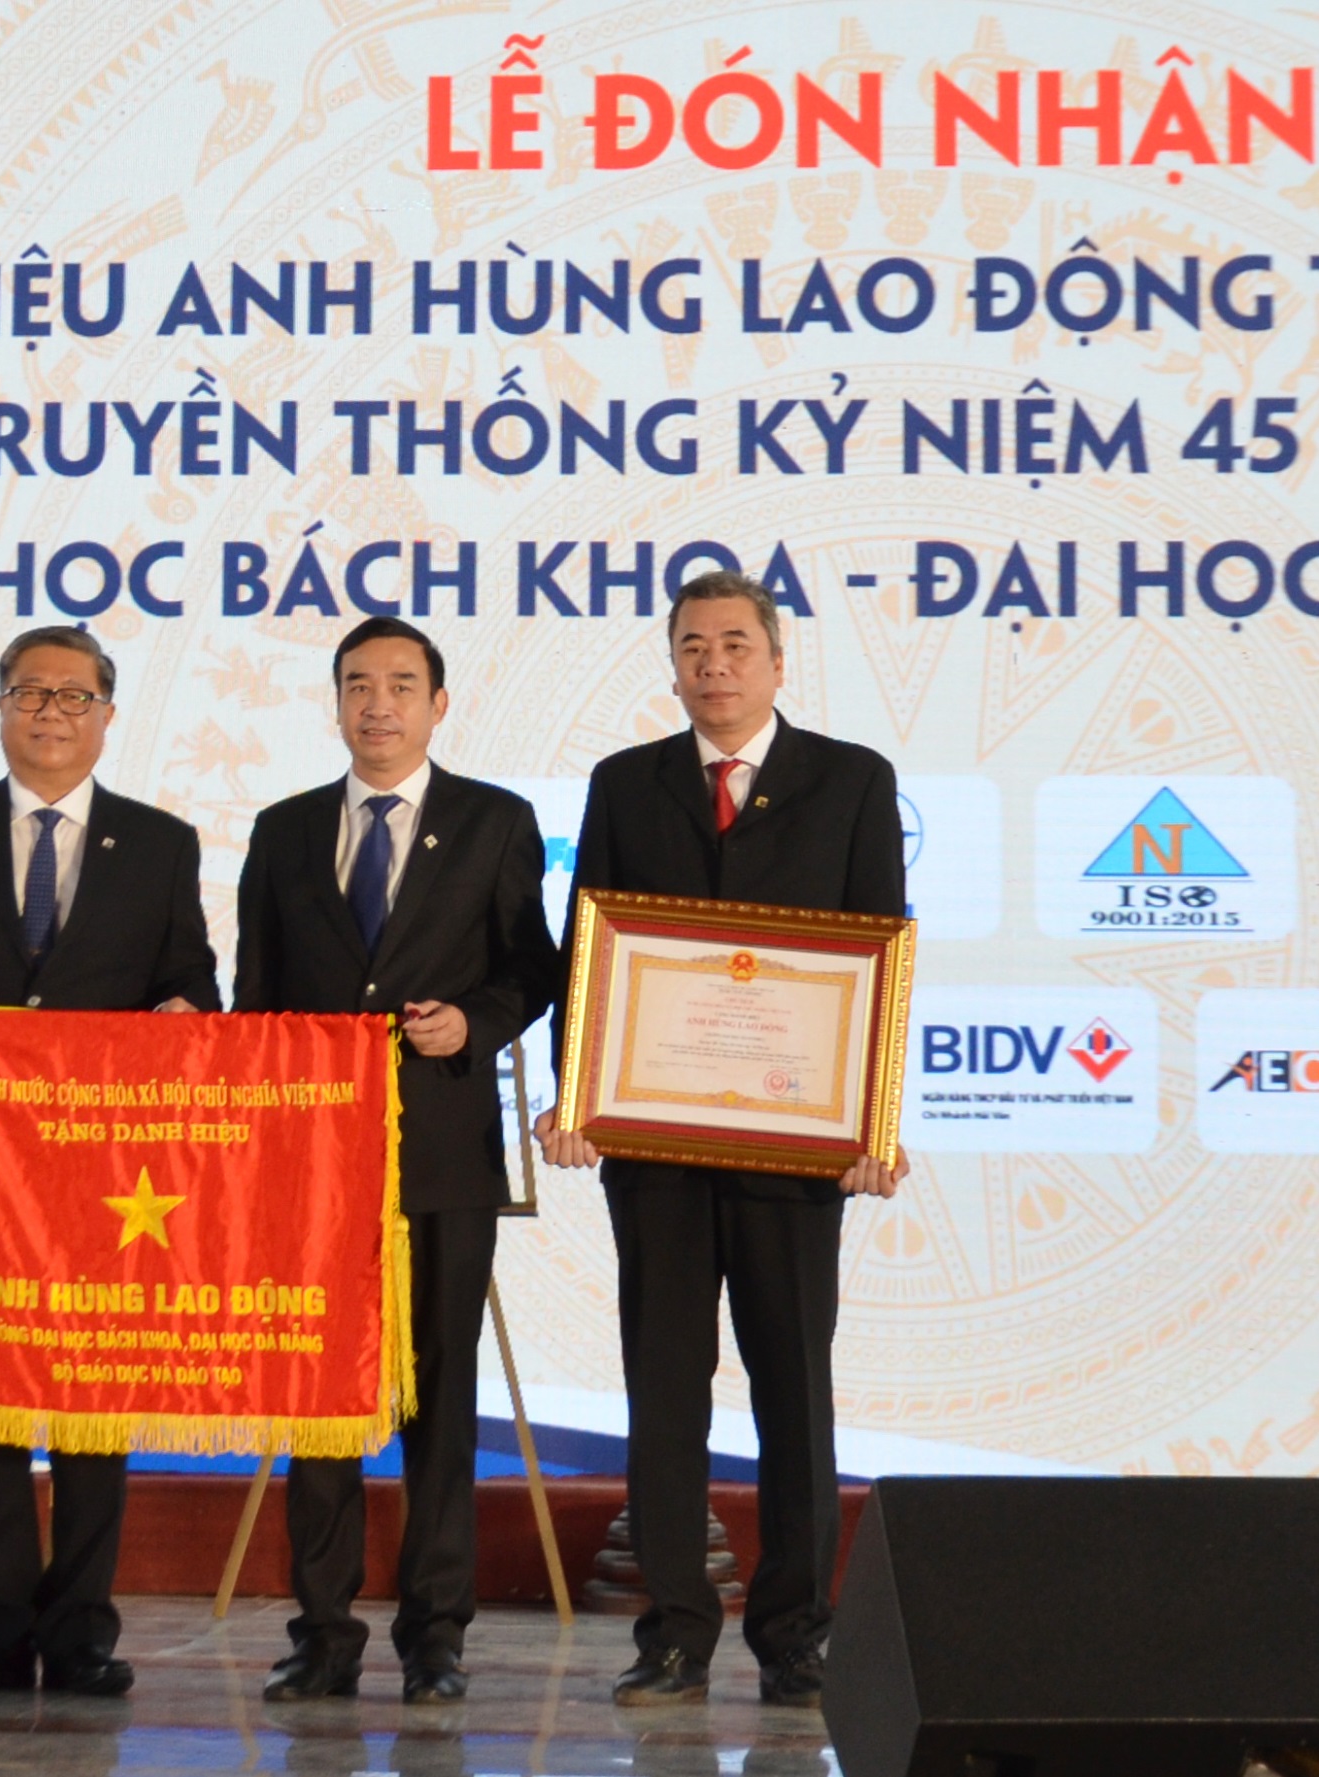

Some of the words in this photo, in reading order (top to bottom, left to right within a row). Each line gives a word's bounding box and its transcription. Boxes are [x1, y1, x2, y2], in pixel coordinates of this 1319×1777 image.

[427, 34, 544, 171] LỄ
[584, 47, 882, 171] ĐÓN
[934, 46, 1314, 185] NHẬN
[157, 261, 372, 336] ANH
[413, 241, 702, 336] HÙNG
[742, 258, 935, 334] LAO
[968, 237, 1274, 347] ĐỘNG
[334, 366, 698, 476] THỐNG
[738, 372, 870, 475] KỶ
[903, 379, 1150, 489] NIỆM
[1181, 397, 1298, 474] 45
[221, 520, 477, 618] BÁCH
[517, 540, 815, 618] KHOA
[847, 574, 877, 588] -
[908, 542, 1078, 632] ĐẠI
[1090, 911, 1240, 926] 9001:2015
[922, 1025, 1064, 1074] BIDV
[9, 1075, 55, 1105] NƯỚC
[56, 1077, 101, 1112] CỘNG
[162, 1076, 191, 1112] HỘI
[194, 1076, 228, 1107] CHỦ
[283, 1077, 318, 1111] VIỆT
[319, 1082, 355, 1104] NAM
[37, 1118, 107, 1147] TẶNG
[112, 1122, 185, 1142] DANH
[189, 1118, 251, 1147] HIỆU
[154, 1282, 220, 1316] LAO
[229, 1276, 327, 1323] ĐỘNG
[95, 1324, 138, 1350] BÁCH
[75, 1357, 114, 1383] GIÁO
[115, 1364, 149, 1388] DỤC
[212, 1366, 243, 1391] TẠO
